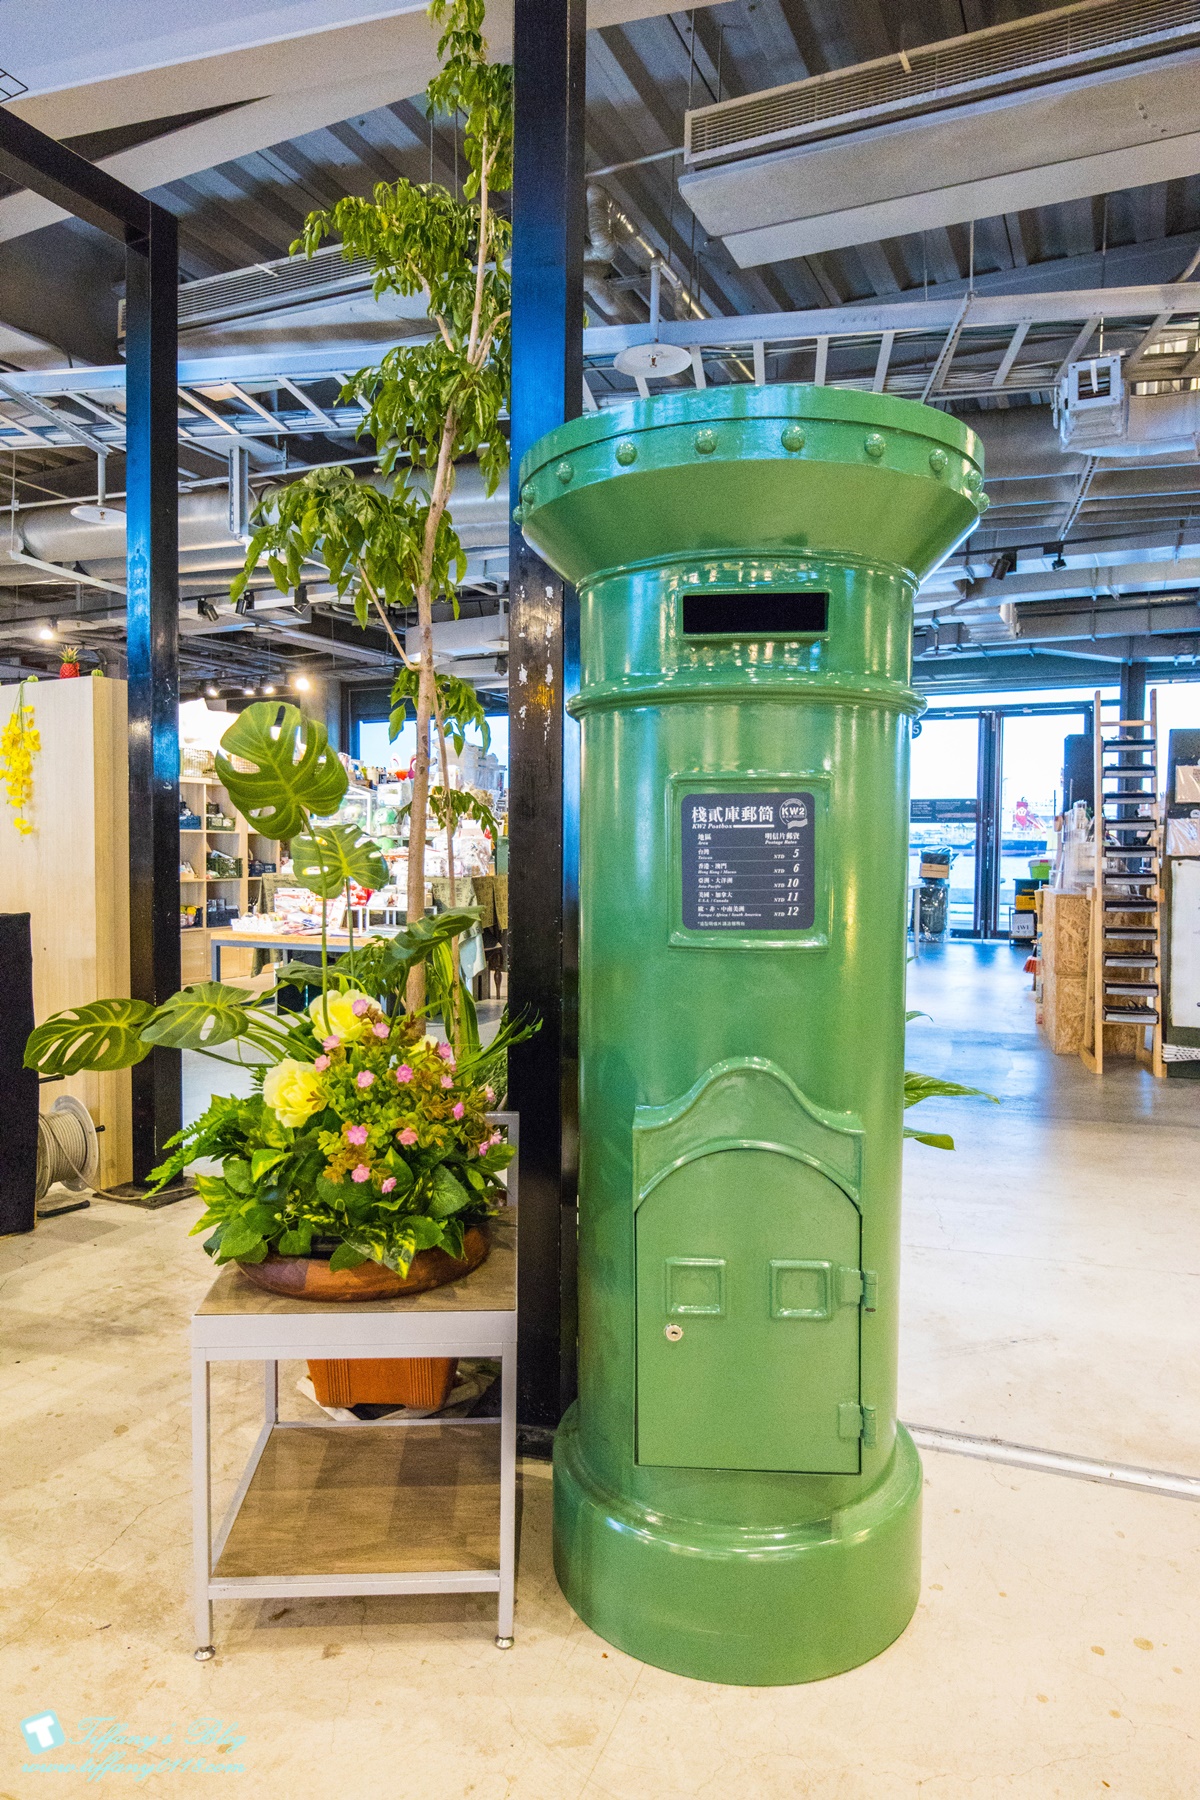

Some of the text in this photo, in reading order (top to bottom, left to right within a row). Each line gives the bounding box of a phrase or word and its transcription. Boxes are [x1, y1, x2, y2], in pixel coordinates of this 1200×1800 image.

[692, 806, 774, 822] 棧貳庫郵筒
[782, 806, 805, 816] KW2
[793, 849, 799, 858] 5
[793, 864, 800, 873] 6
[787, 878, 799, 888] 10
[787, 892, 799, 902] 11
[787, 907, 799, 916] 12
